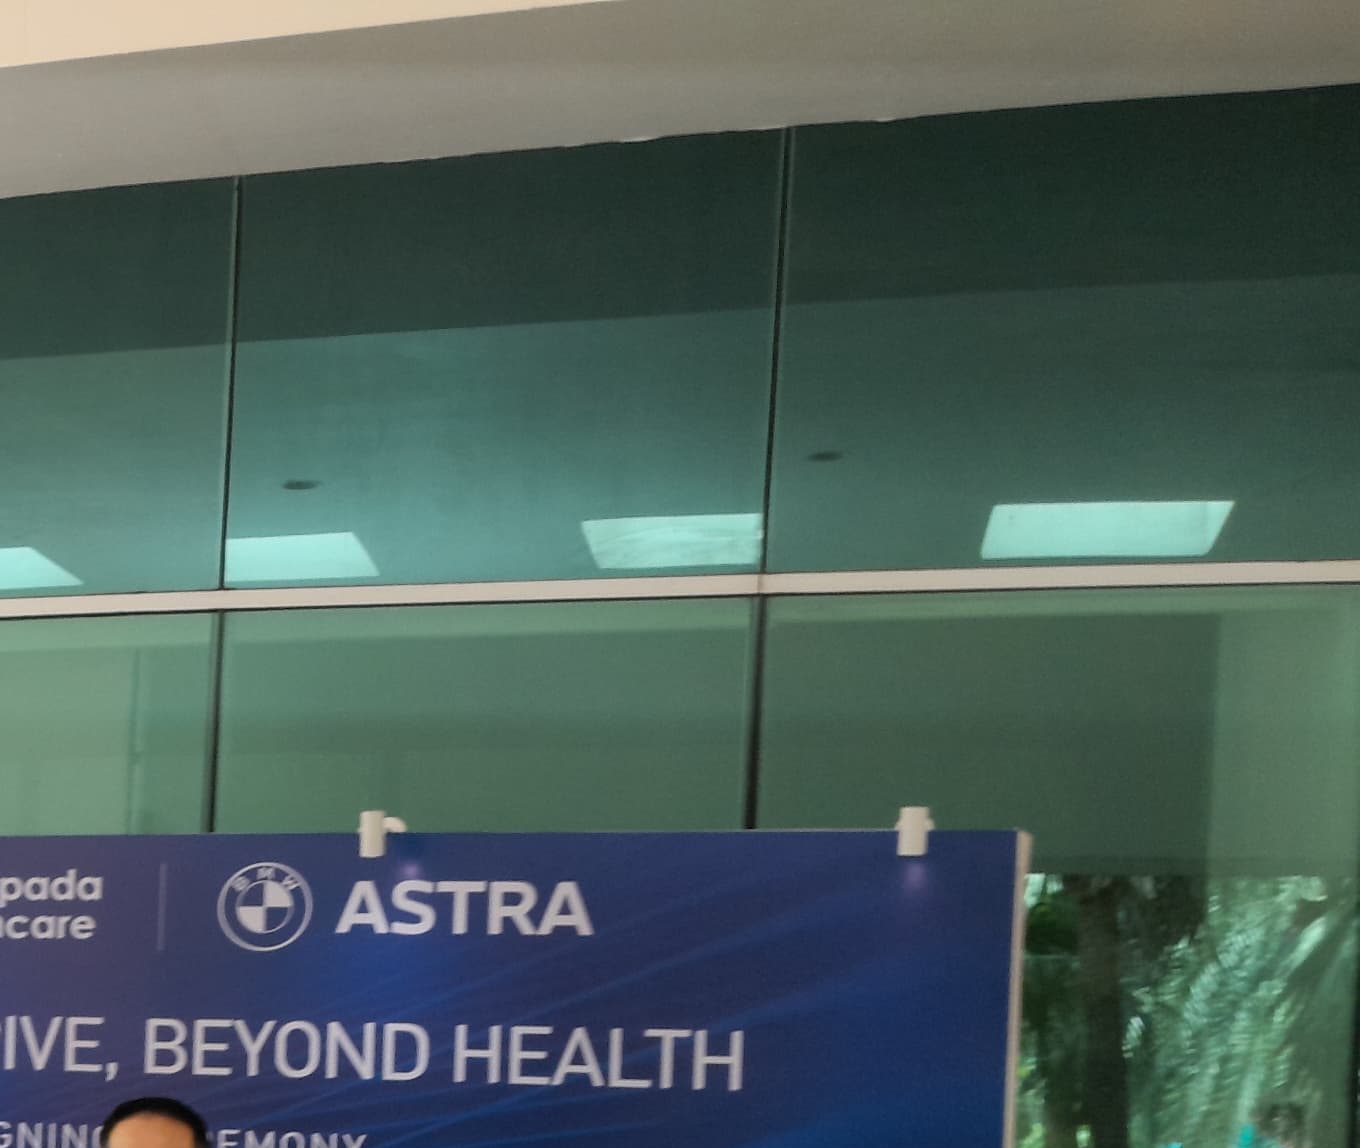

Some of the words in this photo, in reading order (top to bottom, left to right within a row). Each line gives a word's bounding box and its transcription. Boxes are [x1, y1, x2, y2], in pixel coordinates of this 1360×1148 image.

[335, 879, 594, 936] ASTRA
[143, 1017, 430, 1082] BEYOND
[452, 1023, 744, 1091] HEALTH
